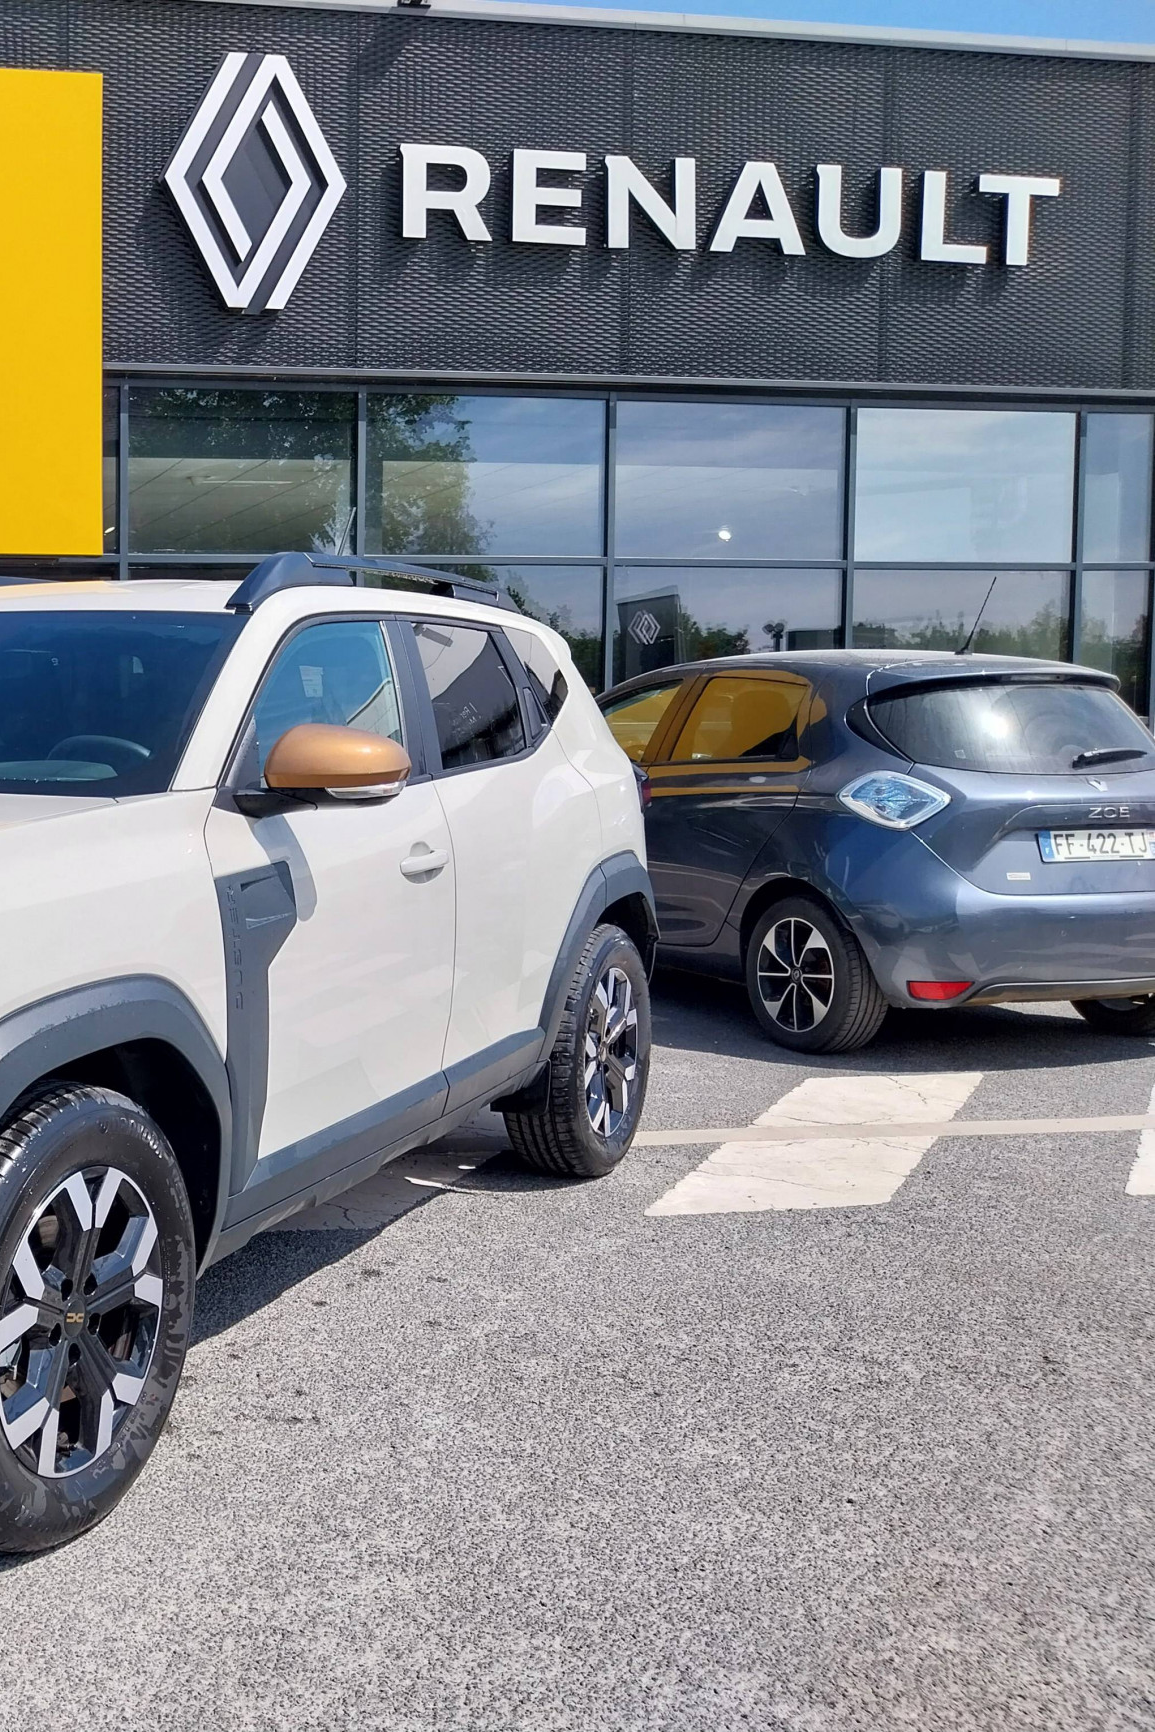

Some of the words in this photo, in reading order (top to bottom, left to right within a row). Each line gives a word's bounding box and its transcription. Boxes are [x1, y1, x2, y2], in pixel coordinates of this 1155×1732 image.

[399, 143, 1060, 267] RENAULT
[1088, 806, 1130, 819] ZOE
[1053, 831, 1147, 855] FF-422-TJ
